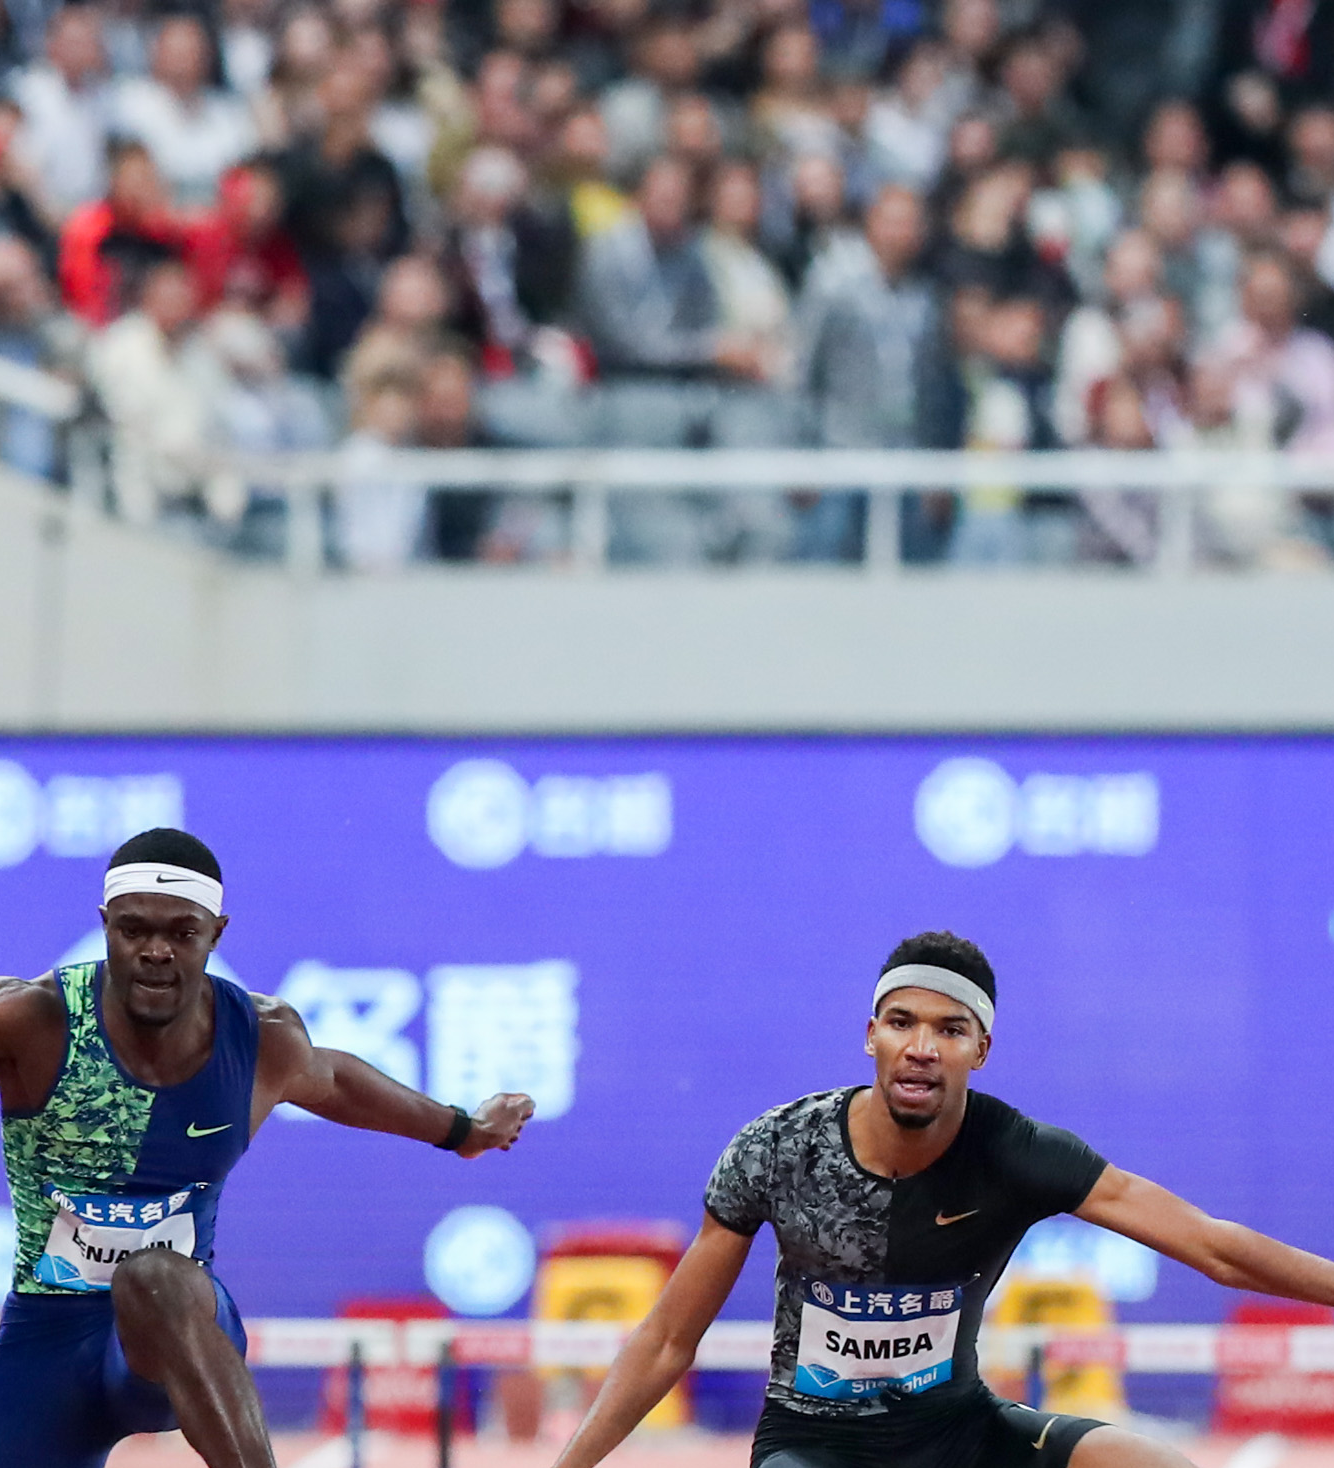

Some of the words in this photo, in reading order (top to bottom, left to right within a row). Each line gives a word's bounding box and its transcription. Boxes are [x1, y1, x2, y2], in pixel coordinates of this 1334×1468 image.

[837, 1289, 955, 1316] 上汽名爵
[825, 1330, 934, 1360] SAMBA
